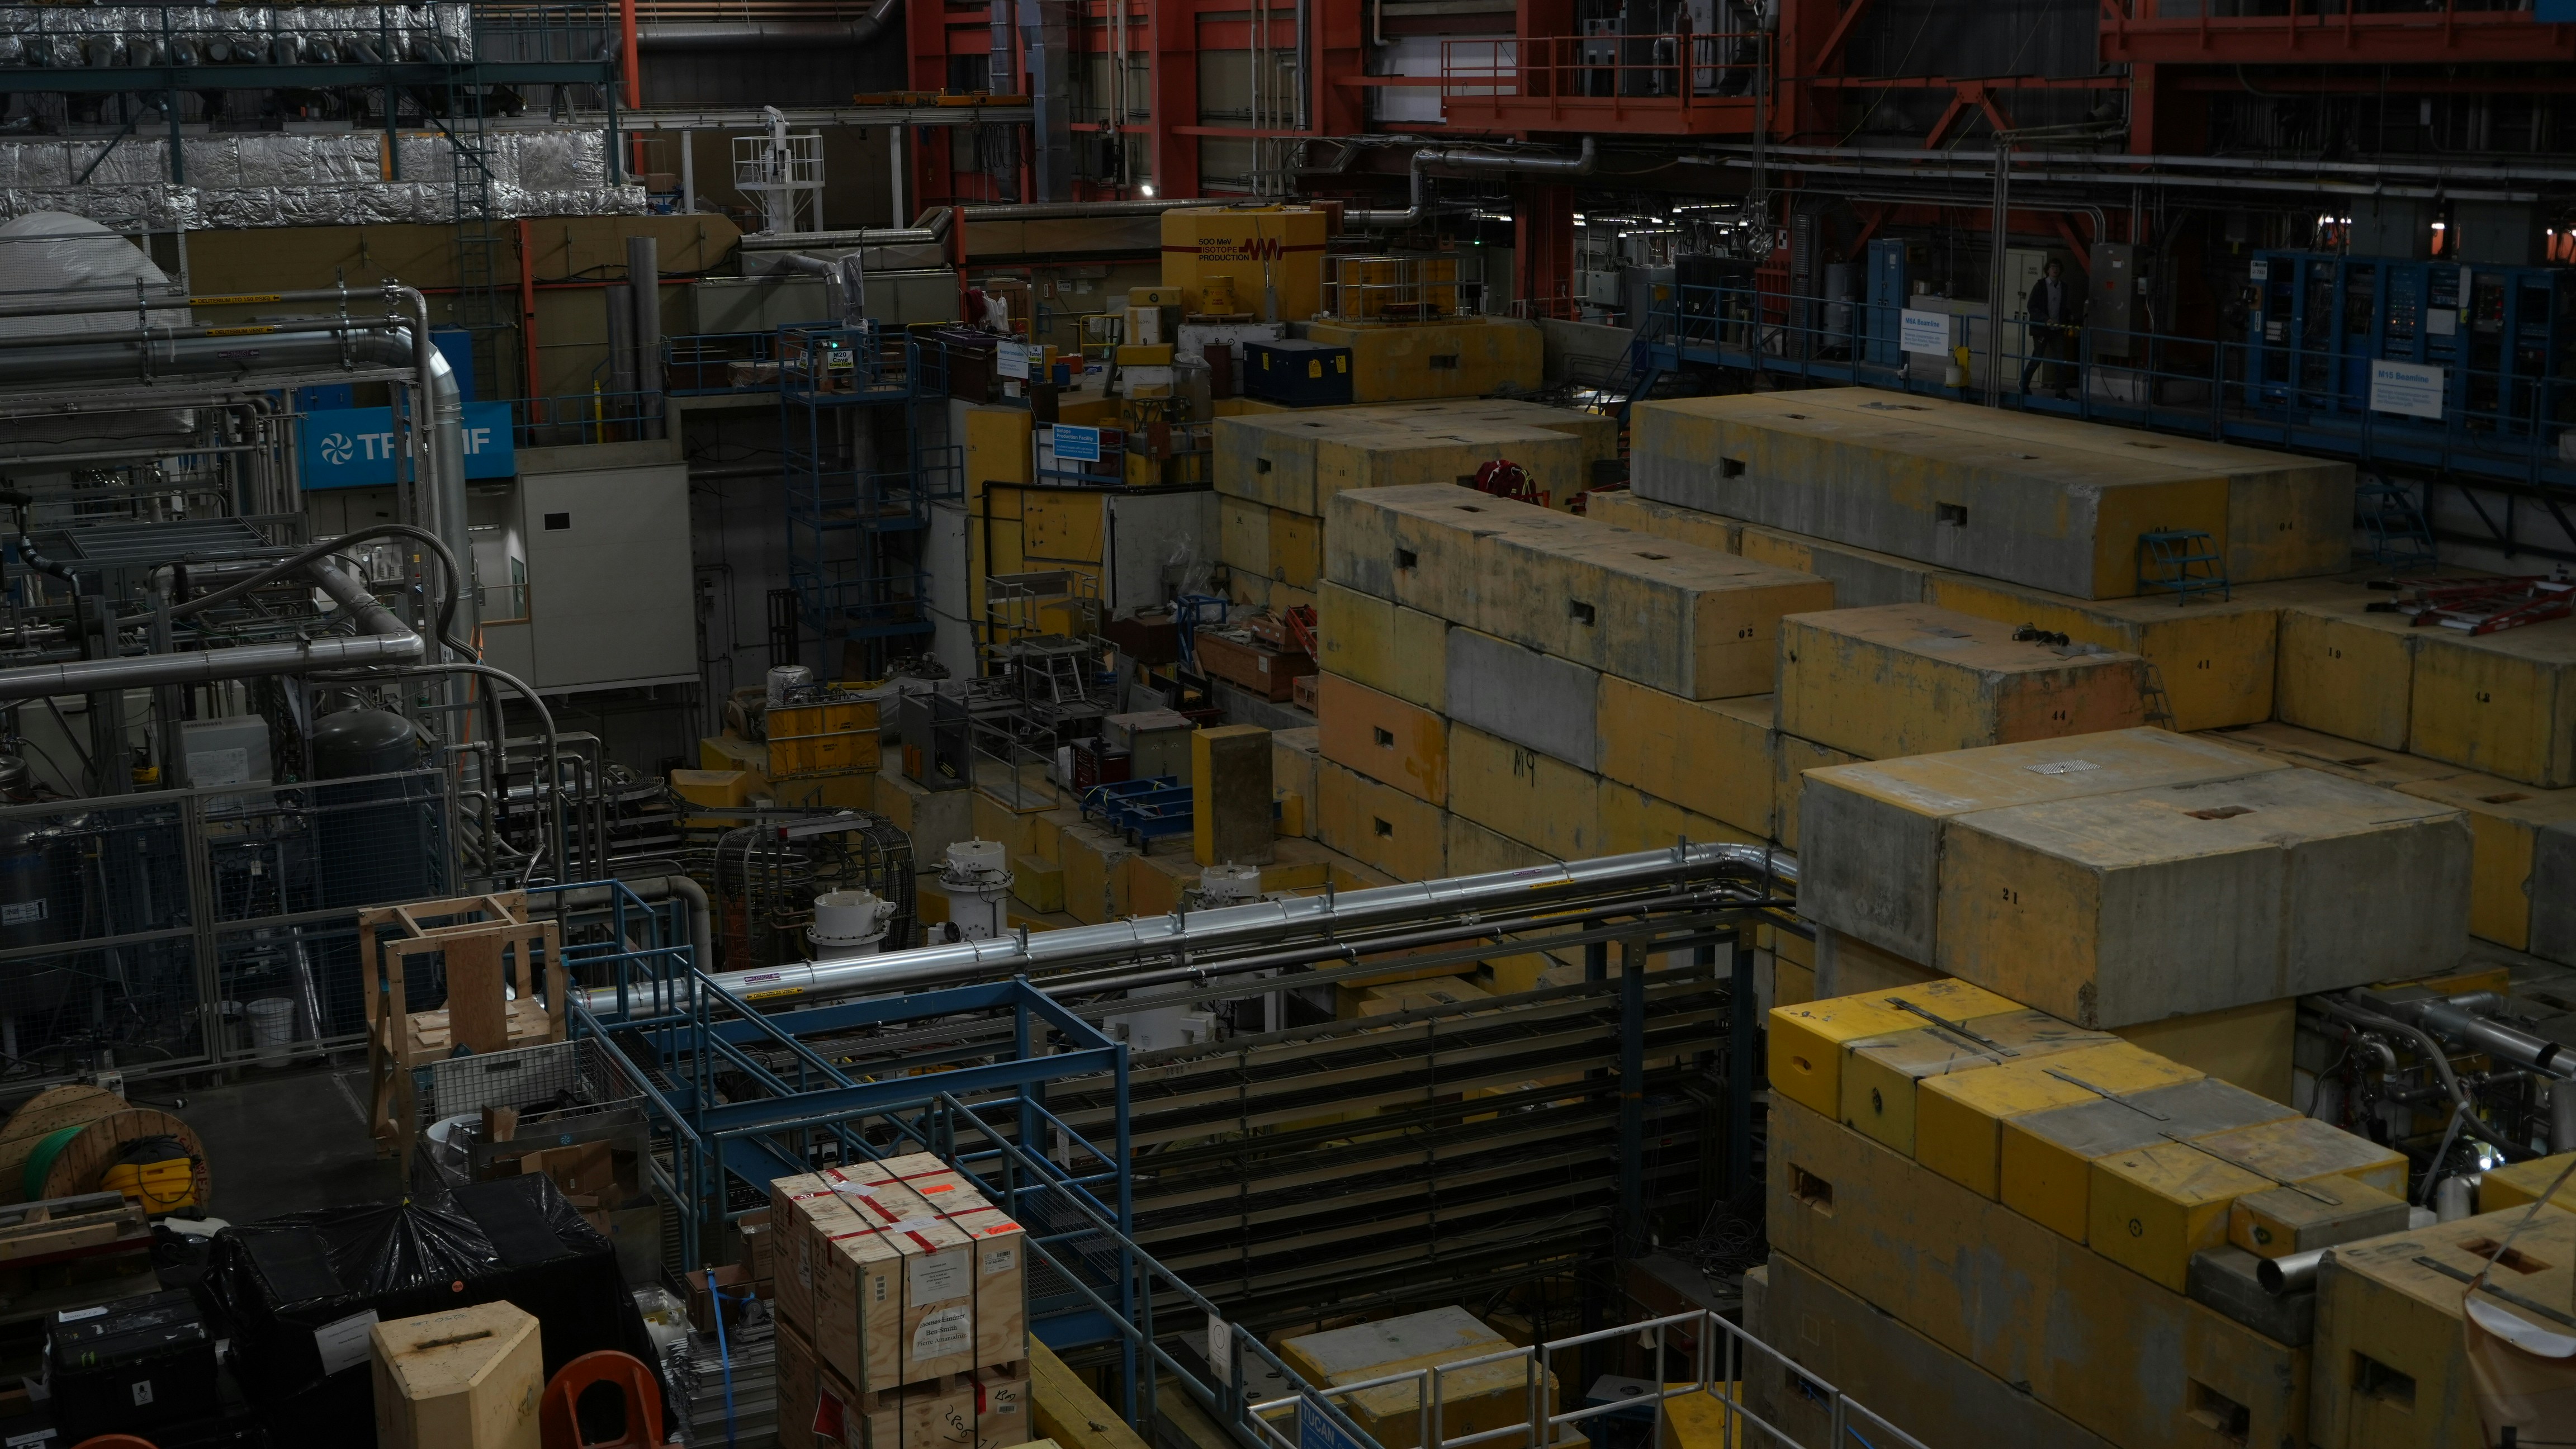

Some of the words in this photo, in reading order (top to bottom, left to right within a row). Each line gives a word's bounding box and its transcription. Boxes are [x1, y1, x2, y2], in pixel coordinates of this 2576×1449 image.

[1917, 319, 1940, 328] Beamline
[2379, 370, 2393, 378] M15
[2396, 372, 2429, 383] Beamline
[2280, 520, 2293, 531] 04
[1739, 628, 1753, 638] 02
[2329, 647, 2341, 659] 19
[2197, 660, 2210, 669] 41
[2052, 710, 2065, 720] 44
[1514, 749, 1534, 787] M9
[2002, 888, 2017, 905] 21
[941, 1314, 966, 1323] Lindner
[939, 1324, 957, 1333] Smith
[1303, 1403, 1334, 1446] TUCAN
